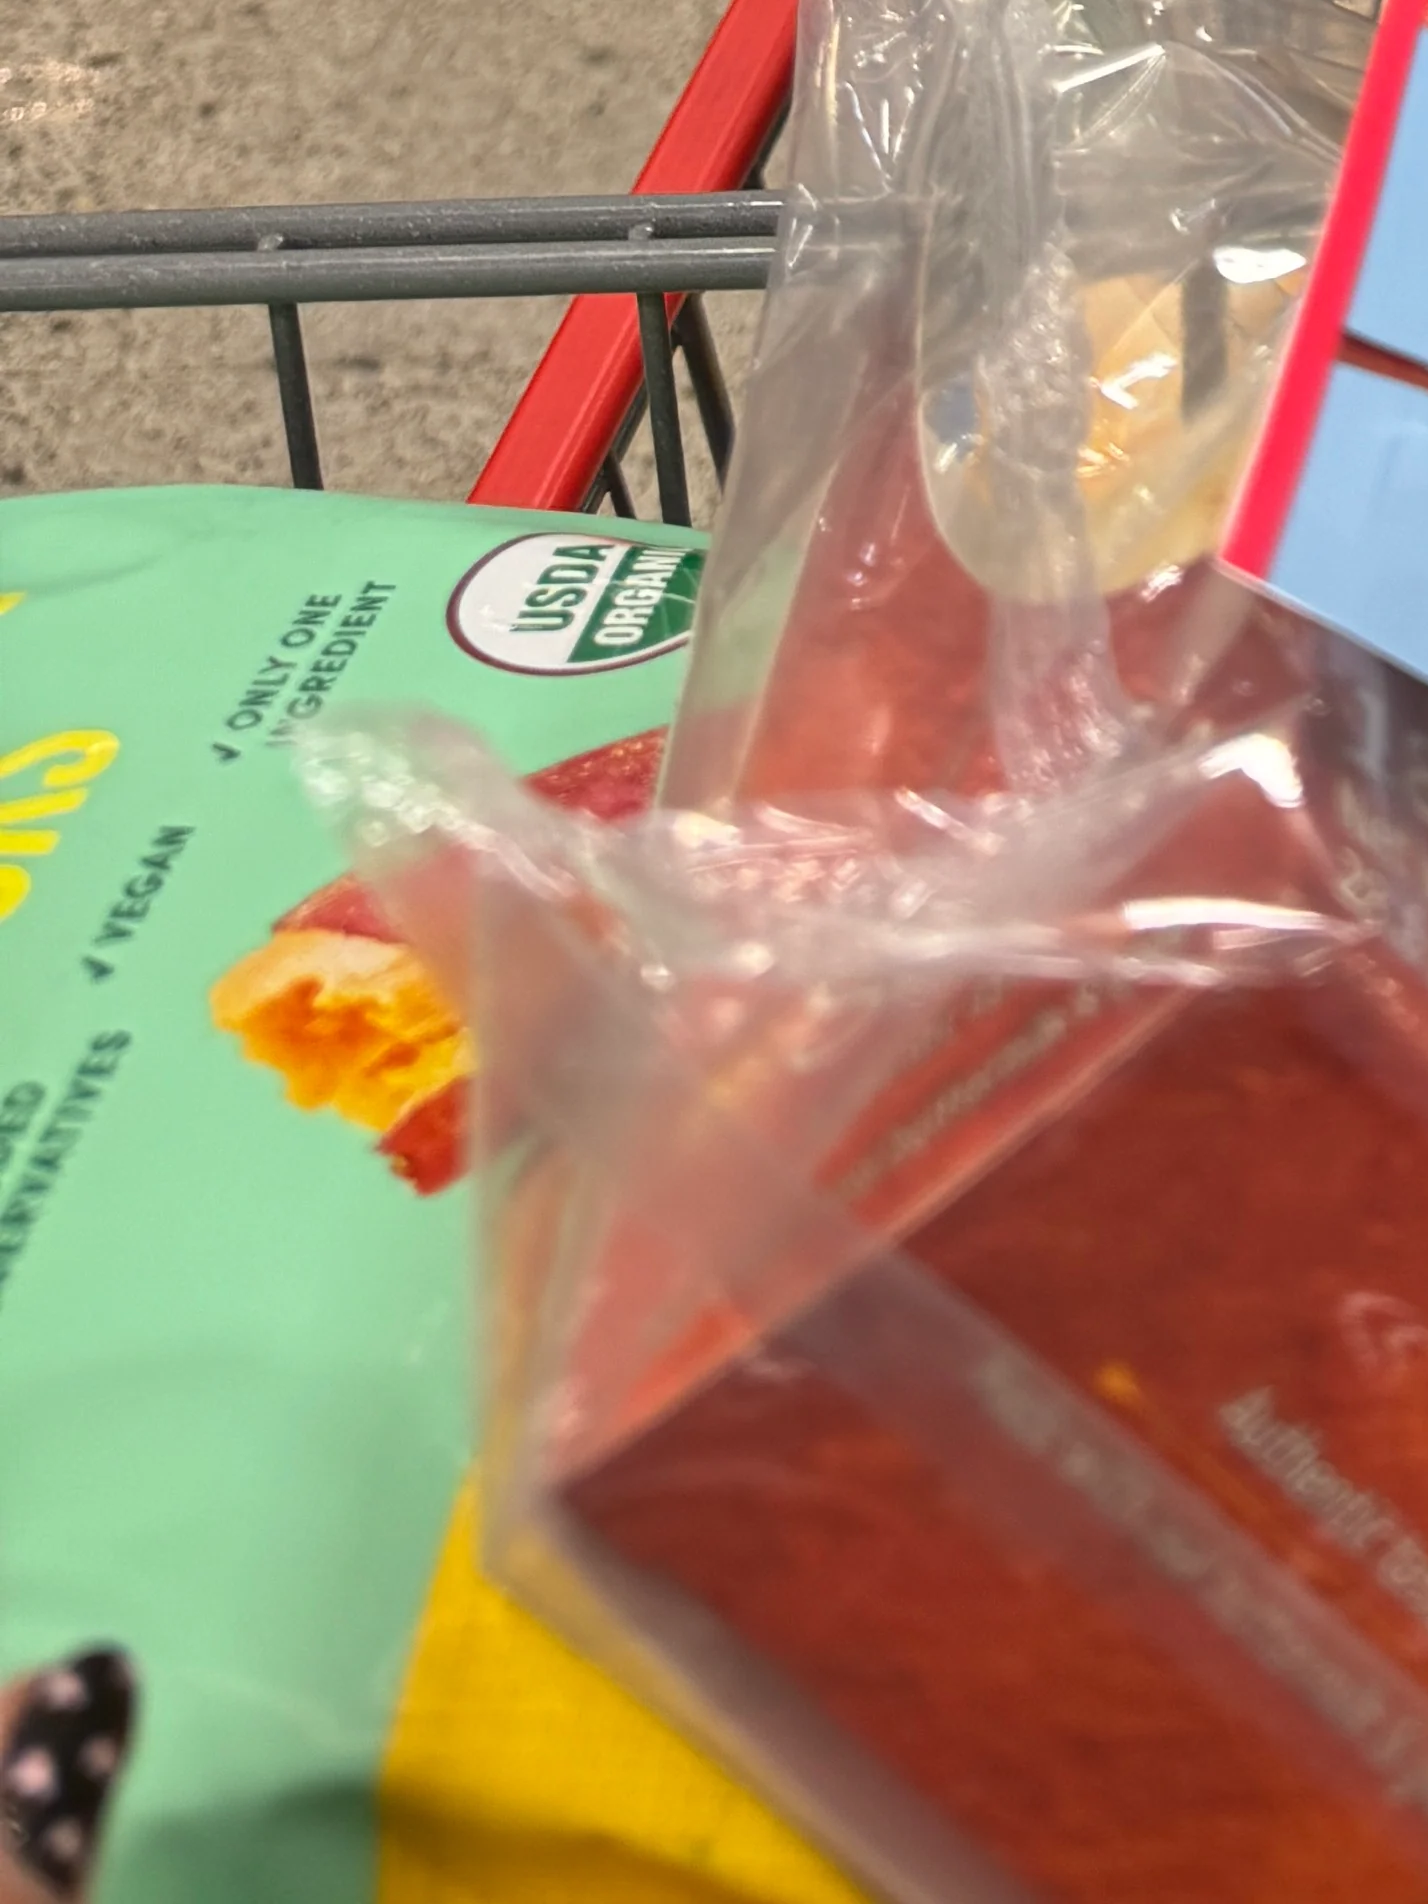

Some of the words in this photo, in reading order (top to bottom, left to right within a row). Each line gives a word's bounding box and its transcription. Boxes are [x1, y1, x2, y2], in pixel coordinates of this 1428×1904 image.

[509, 543, 617, 632] USDA
[594, 548, 694, 646] ORGANI
[224, 655, 298, 731] ONLY
[279, 594, 343, 649] ONE
[91, 825, 197, 945] VEGAN
